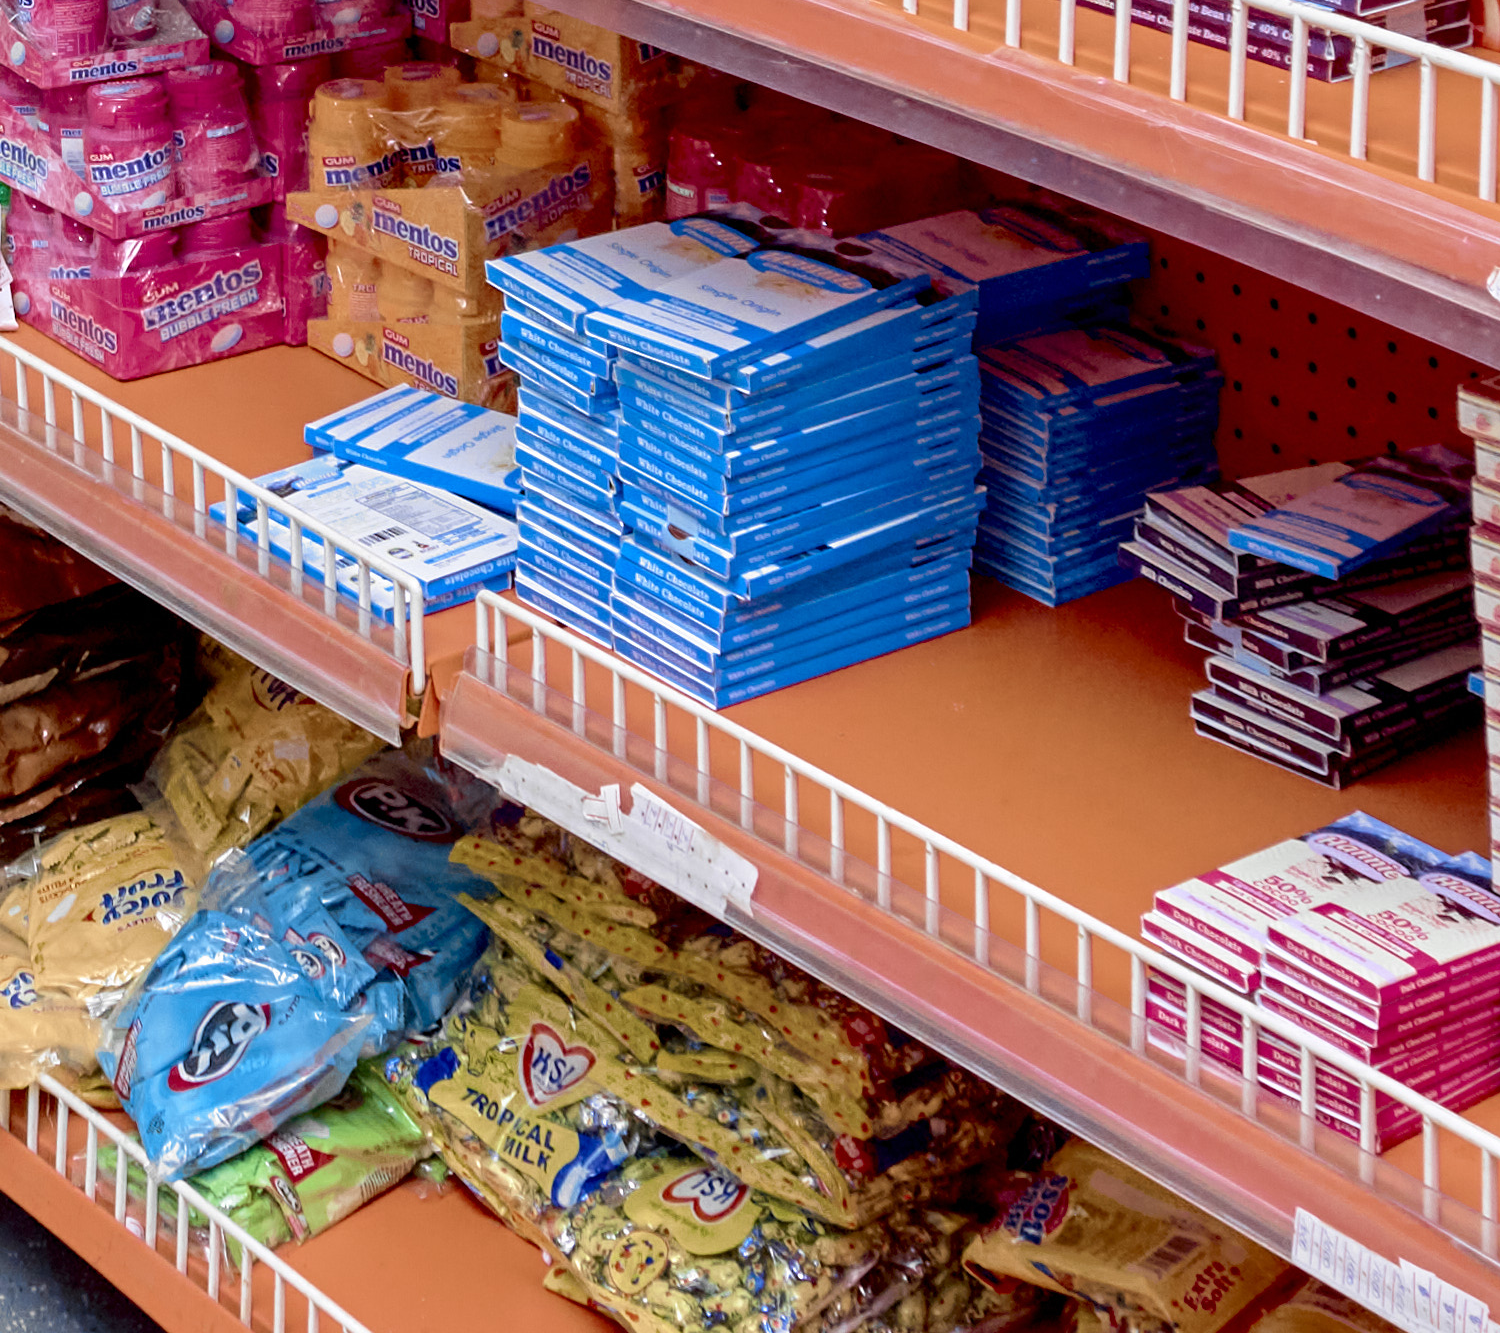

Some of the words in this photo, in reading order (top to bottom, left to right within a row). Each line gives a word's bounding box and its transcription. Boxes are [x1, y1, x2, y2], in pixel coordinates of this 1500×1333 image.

[71, 58, 140, 81] mentos
[371, 204, 460, 261] mentos
[408, 241, 460, 276] TROPICAL
[143, 258, 263, 331] mentos
